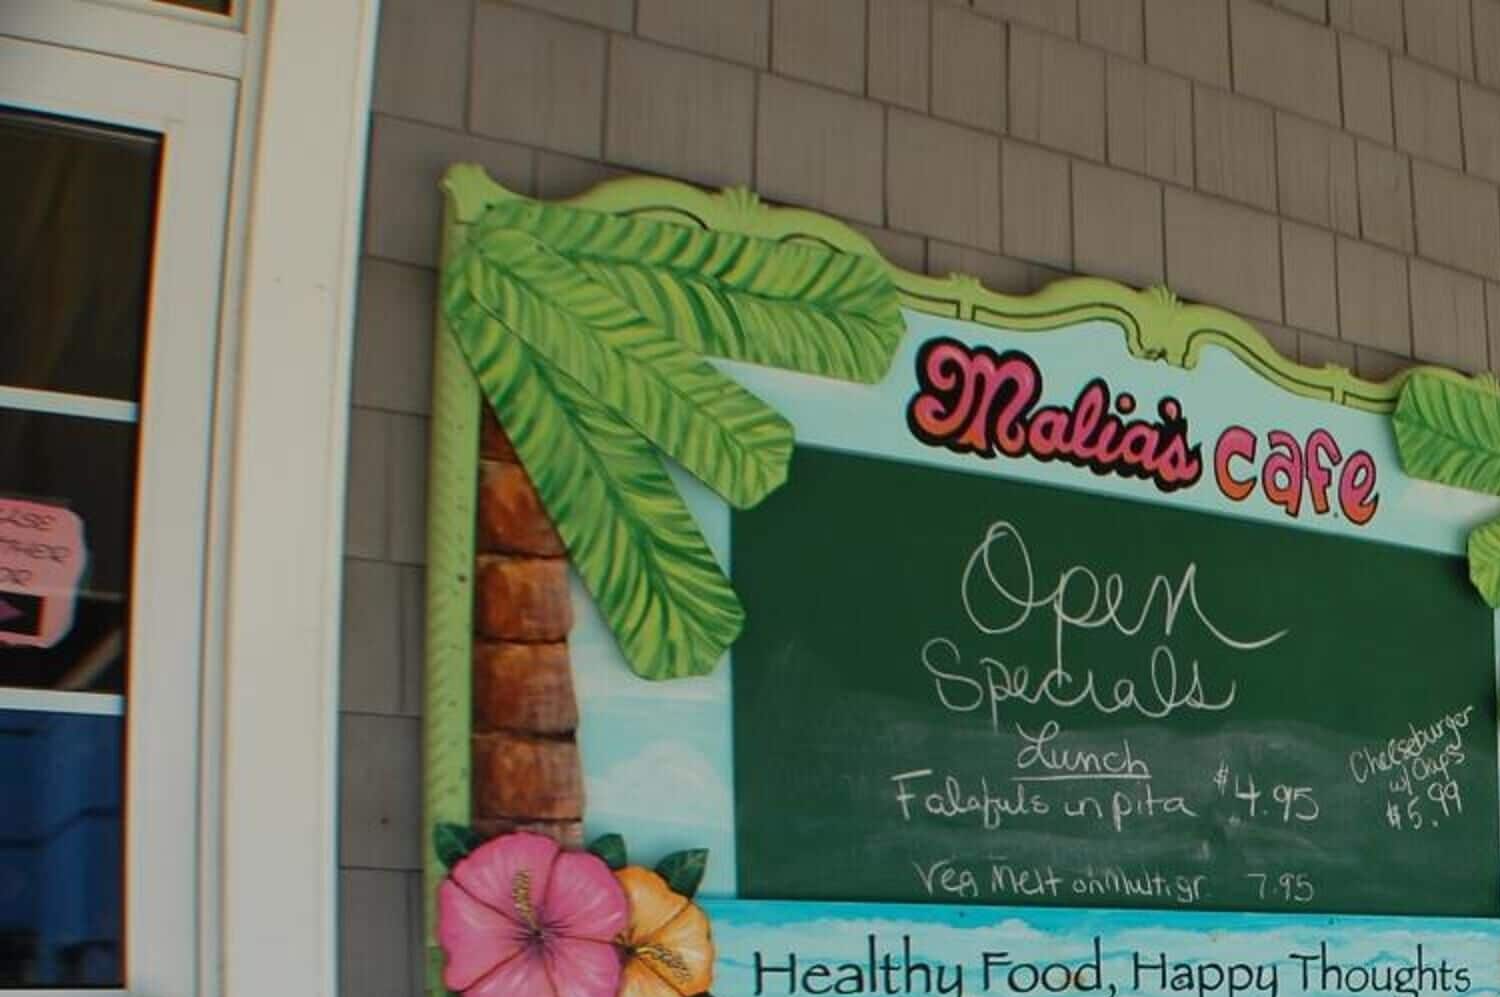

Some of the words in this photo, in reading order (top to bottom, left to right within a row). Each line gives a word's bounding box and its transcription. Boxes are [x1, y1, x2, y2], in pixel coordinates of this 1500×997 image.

[907, 336, 1202, 492] Malia's
[962, 521, 1289, 688] Open
[921, 638, 1236, 732] Specials
[1017, 720, 1150, 773] Lunch
[1064, 797, 1103, 819] in
[1112, 782, 1198, 832] pita
[1247, 872, 1315, 902] 7.95
